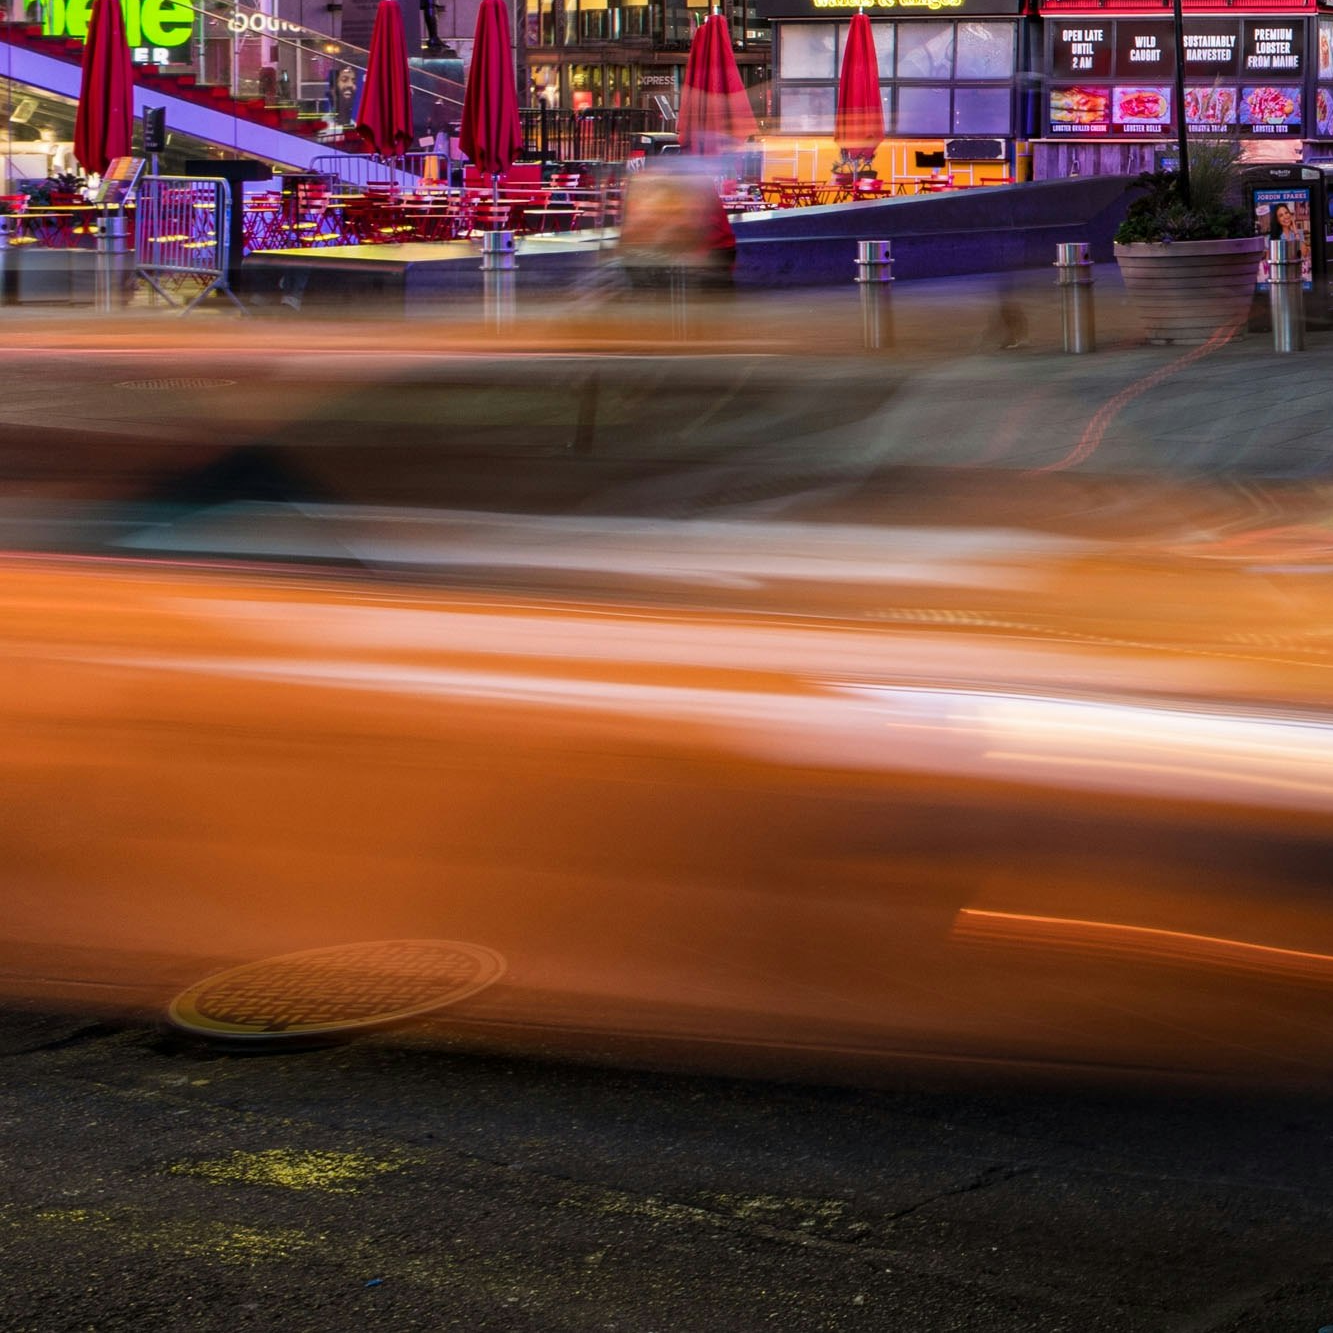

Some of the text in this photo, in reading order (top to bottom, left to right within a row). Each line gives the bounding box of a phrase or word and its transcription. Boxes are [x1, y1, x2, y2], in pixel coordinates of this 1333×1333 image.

[1063, 29, 1103, 41] OPEN LATE
[1254, 28, 1293, 41] PREMIUM
[1135, 36, 1156, 48] WILD
[1183, 35, 1236, 48] SUSTAINABLY
[1072, 43, 1094, 55] UNTIL
[1256, 42, 1291, 55] LOBSTER
[1130, 49, 1161, 62] CAUGHT
[1186, 49, 1232, 62] HARVESTED
[1247, 55, 1299, 69] FROM MAINE
[1073, 56, 1093, 69] 2 AM
[640, 75, 675, 85] XPRESS
[1257, 193, 1281, 201] JORDIN
